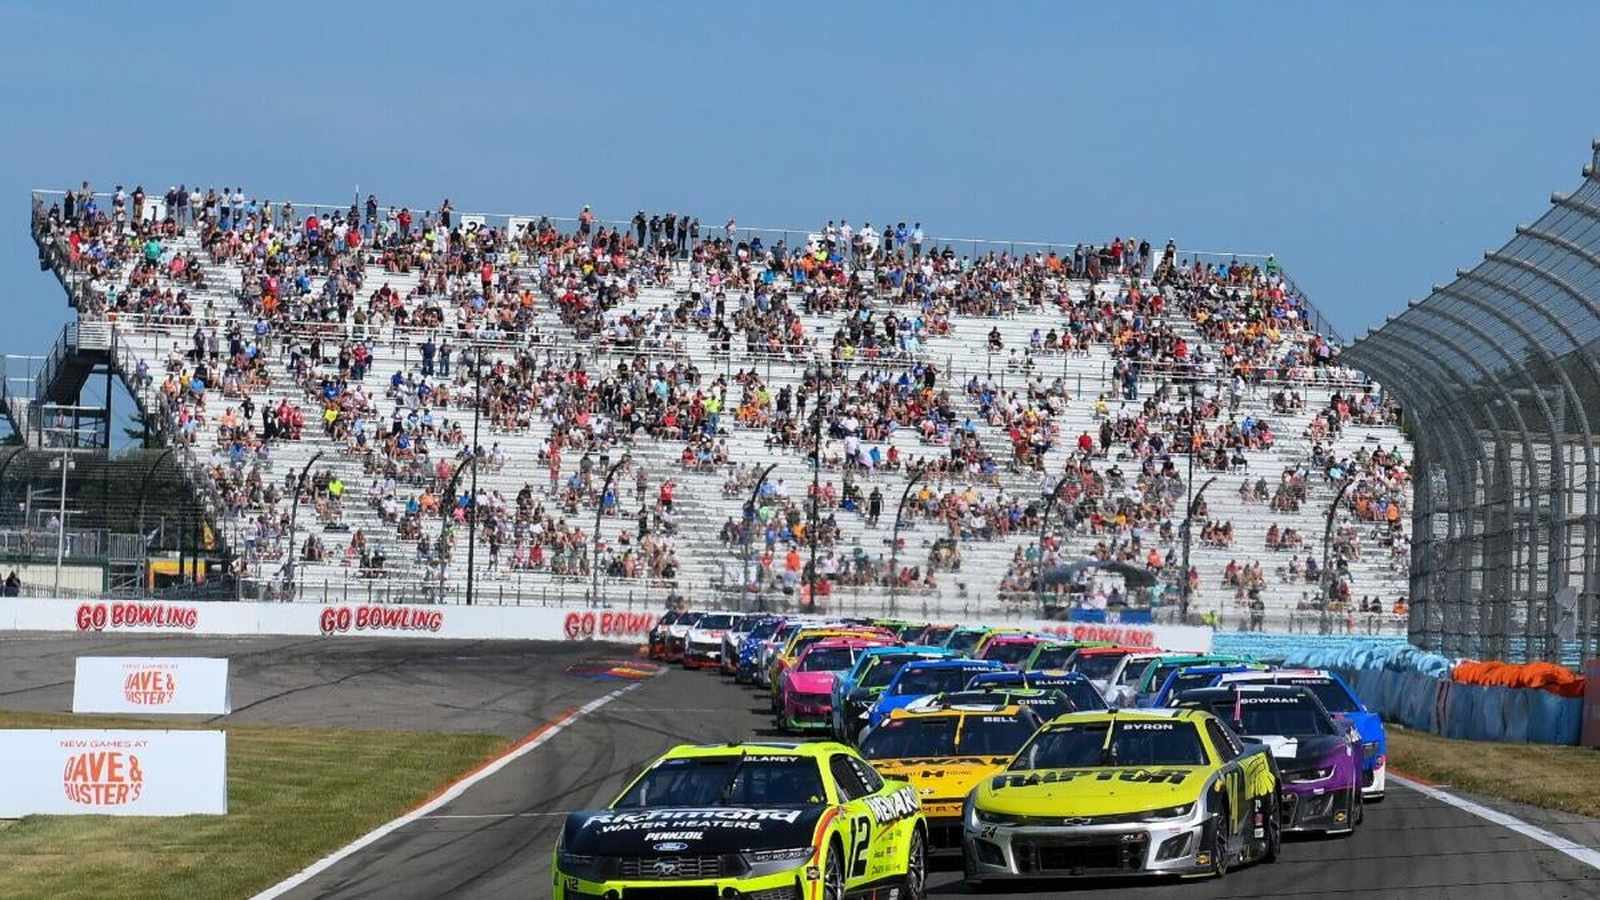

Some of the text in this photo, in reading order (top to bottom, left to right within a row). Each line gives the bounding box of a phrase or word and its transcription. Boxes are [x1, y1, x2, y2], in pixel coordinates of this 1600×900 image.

[76, 601, 198, 630] GO BOWLING
[319, 602, 444, 633] GO BOWLING
[565, 610, 657, 639] GO BOWL
[1240, 697, 1299, 705] BOWMAN
[982, 715, 1019, 723] BELL
[1122, 722, 1174, 731] BYRON
[60, 740, 148, 748] NEW GAMES AT
[743, 755, 799, 763] BLANEY
[64, 752, 143, 782] DAVE &
[64, 784, 142, 805] BUSTER'S
[602, 819, 762, 833] WATER HEATERS
[644, 831, 705, 842] PENNZOIL
[846, 815, 872, 878] 12
